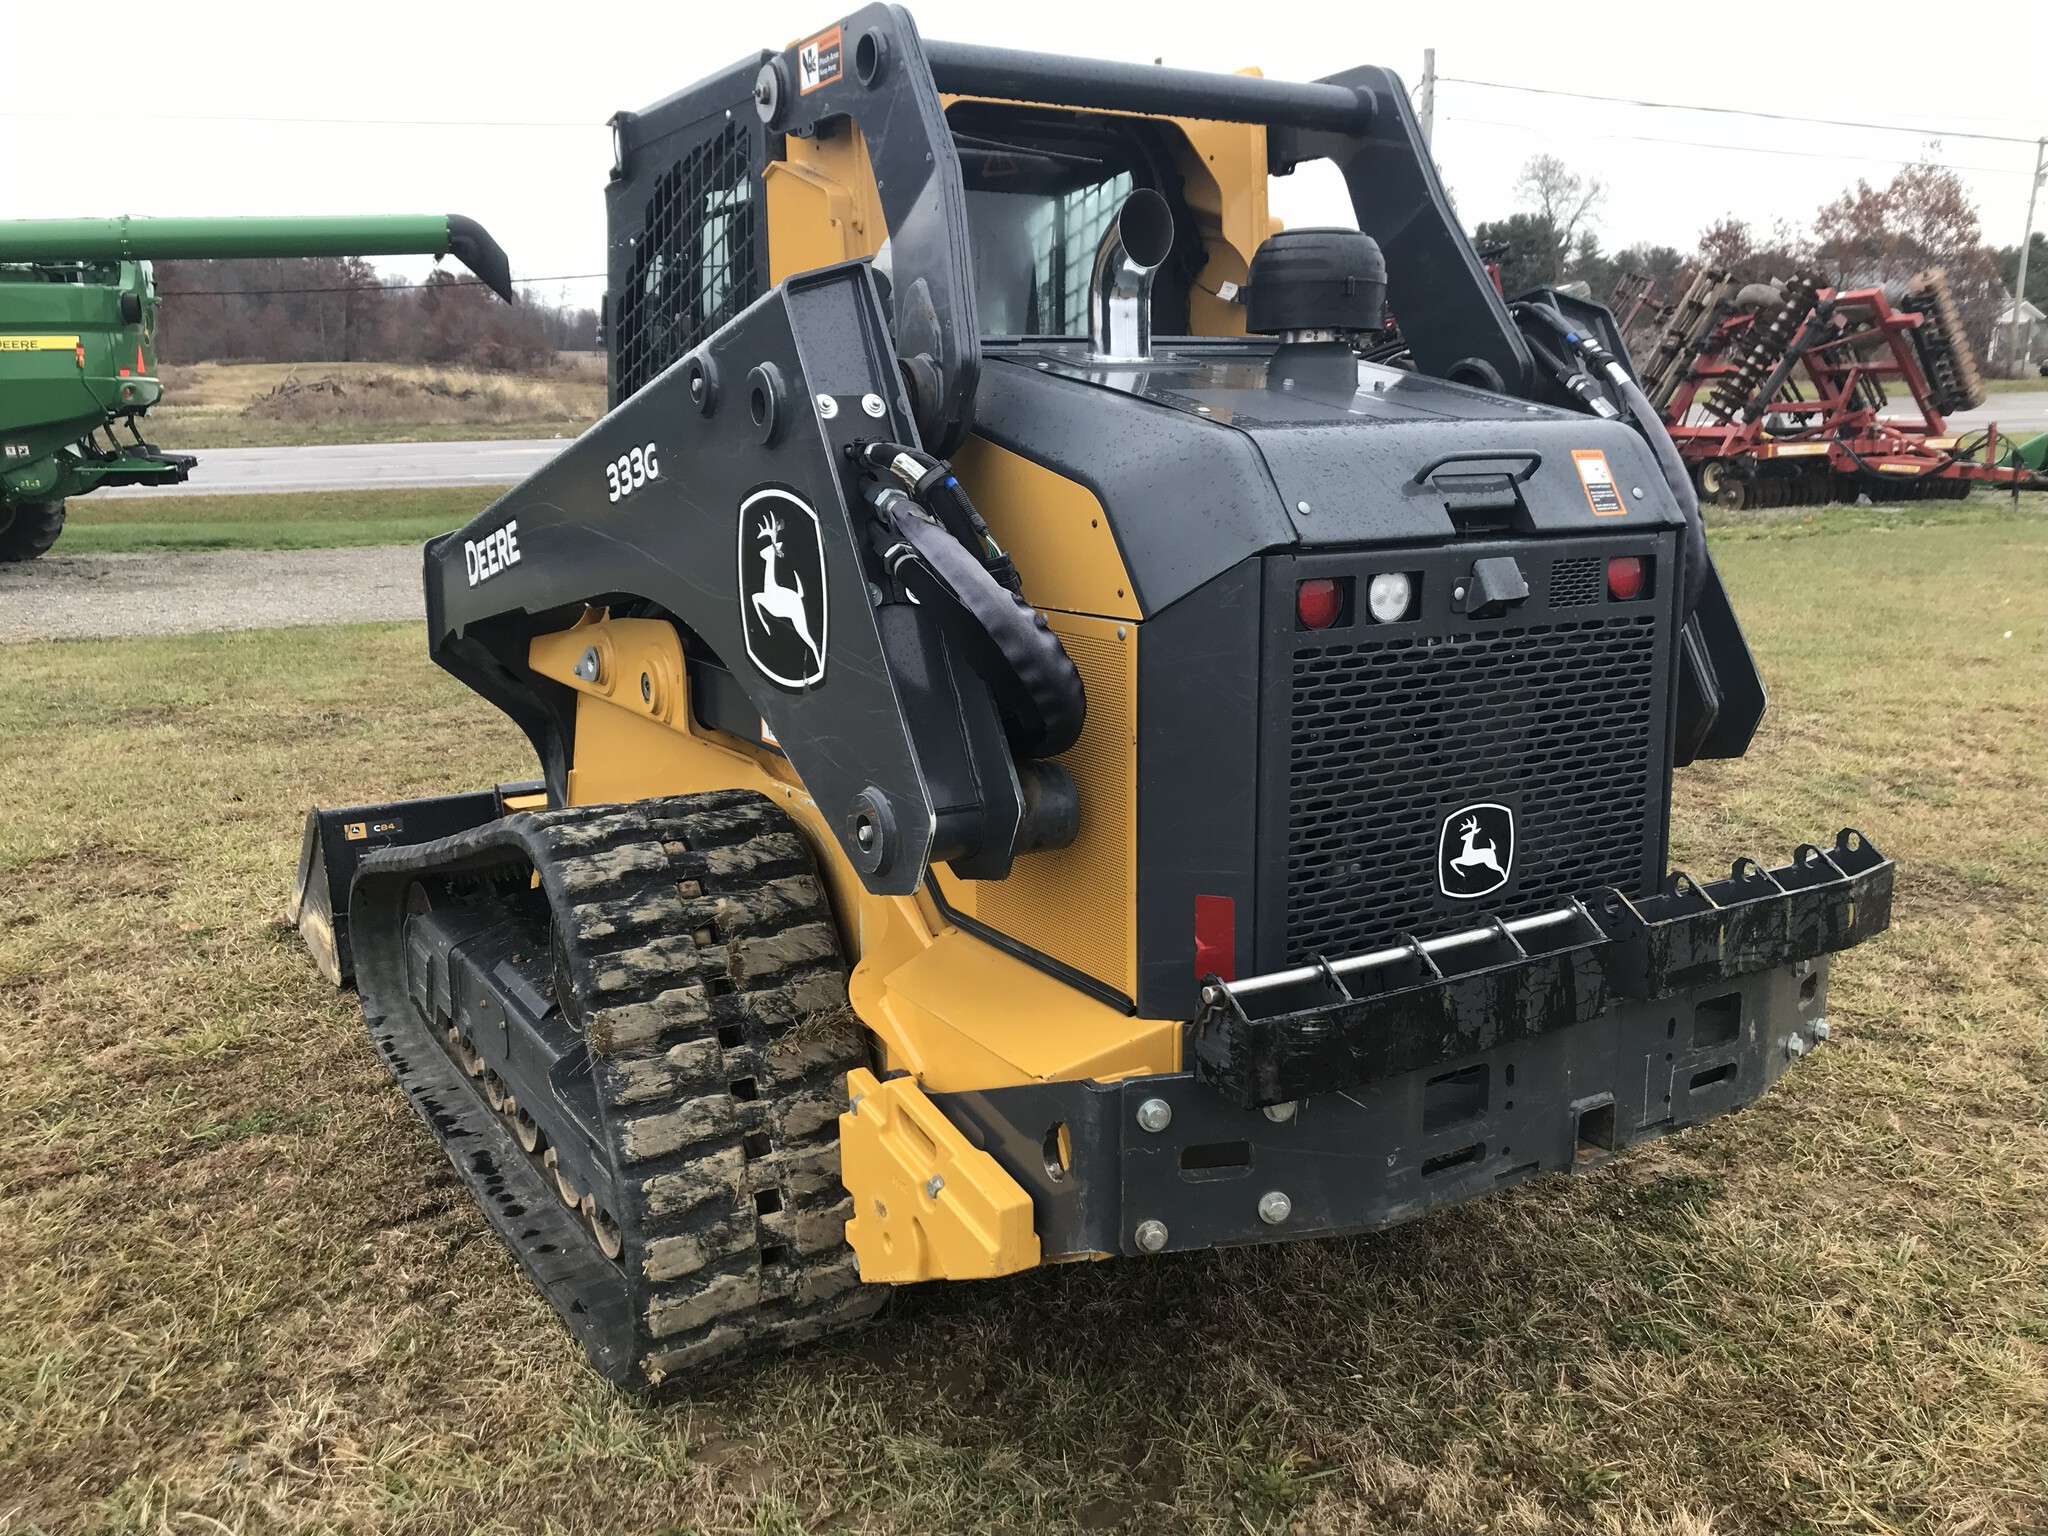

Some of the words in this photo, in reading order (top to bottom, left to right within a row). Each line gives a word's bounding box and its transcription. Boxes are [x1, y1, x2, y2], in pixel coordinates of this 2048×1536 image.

[0, 340, 39, 349] EERE
[606, 442, 659, 502] 333G
[464, 519, 521, 587] DEERE
